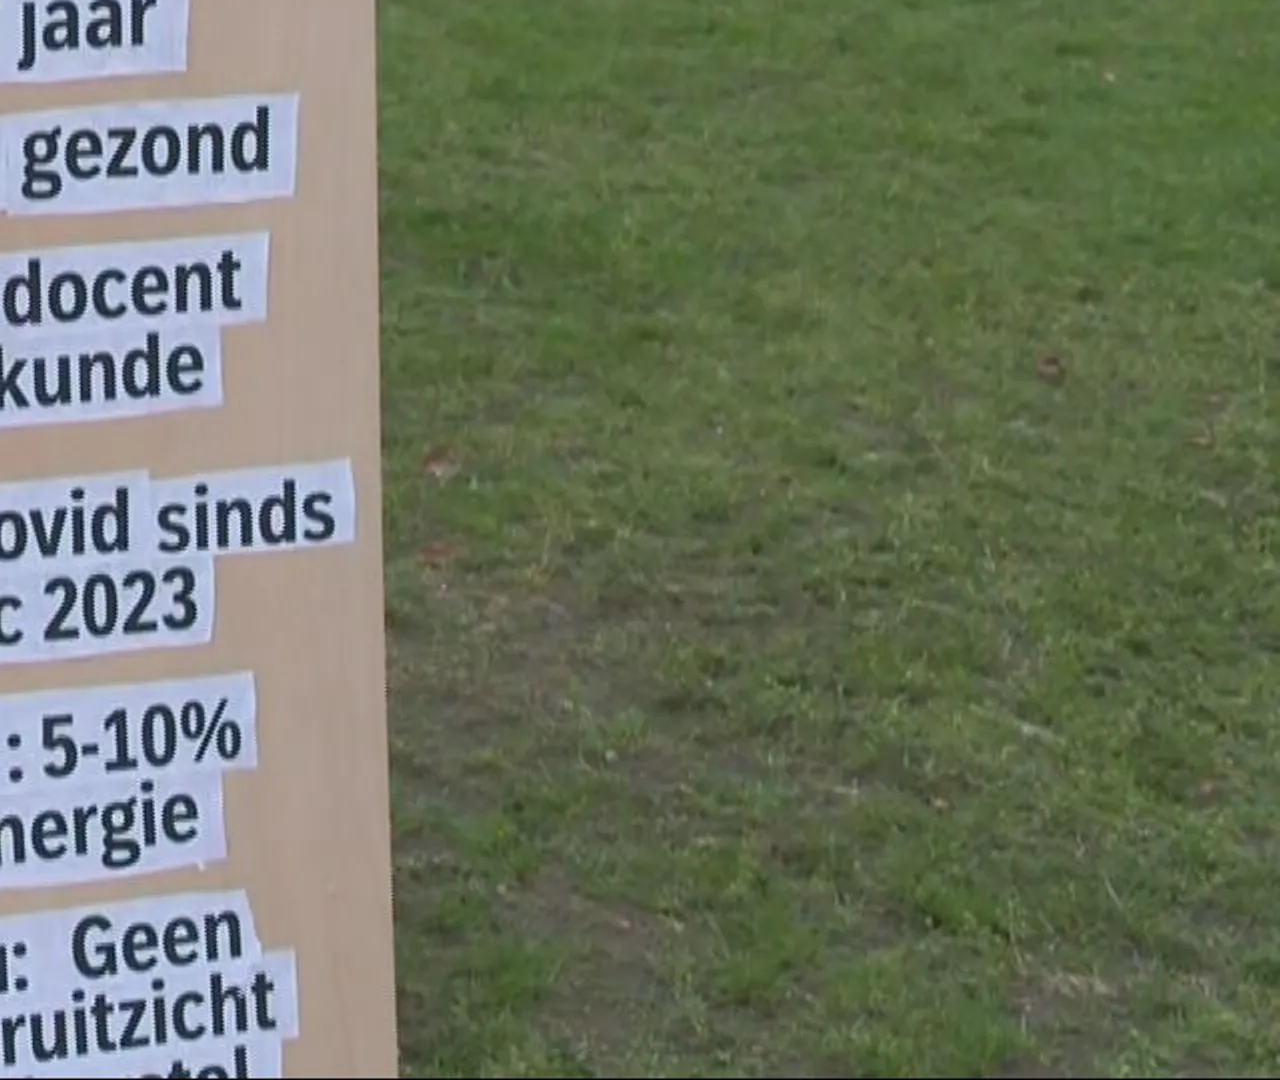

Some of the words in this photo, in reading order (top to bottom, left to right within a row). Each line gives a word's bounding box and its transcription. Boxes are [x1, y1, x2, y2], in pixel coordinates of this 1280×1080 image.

[21, 106, 272, 200] gezond
[3, 249, 242, 327] docent
[157, 478, 336, 554] sinds
[42, 566, 198, 642] 2023
[41, 698, 242, 779] 5-10%
[71, 907, 242, 979] Geen
